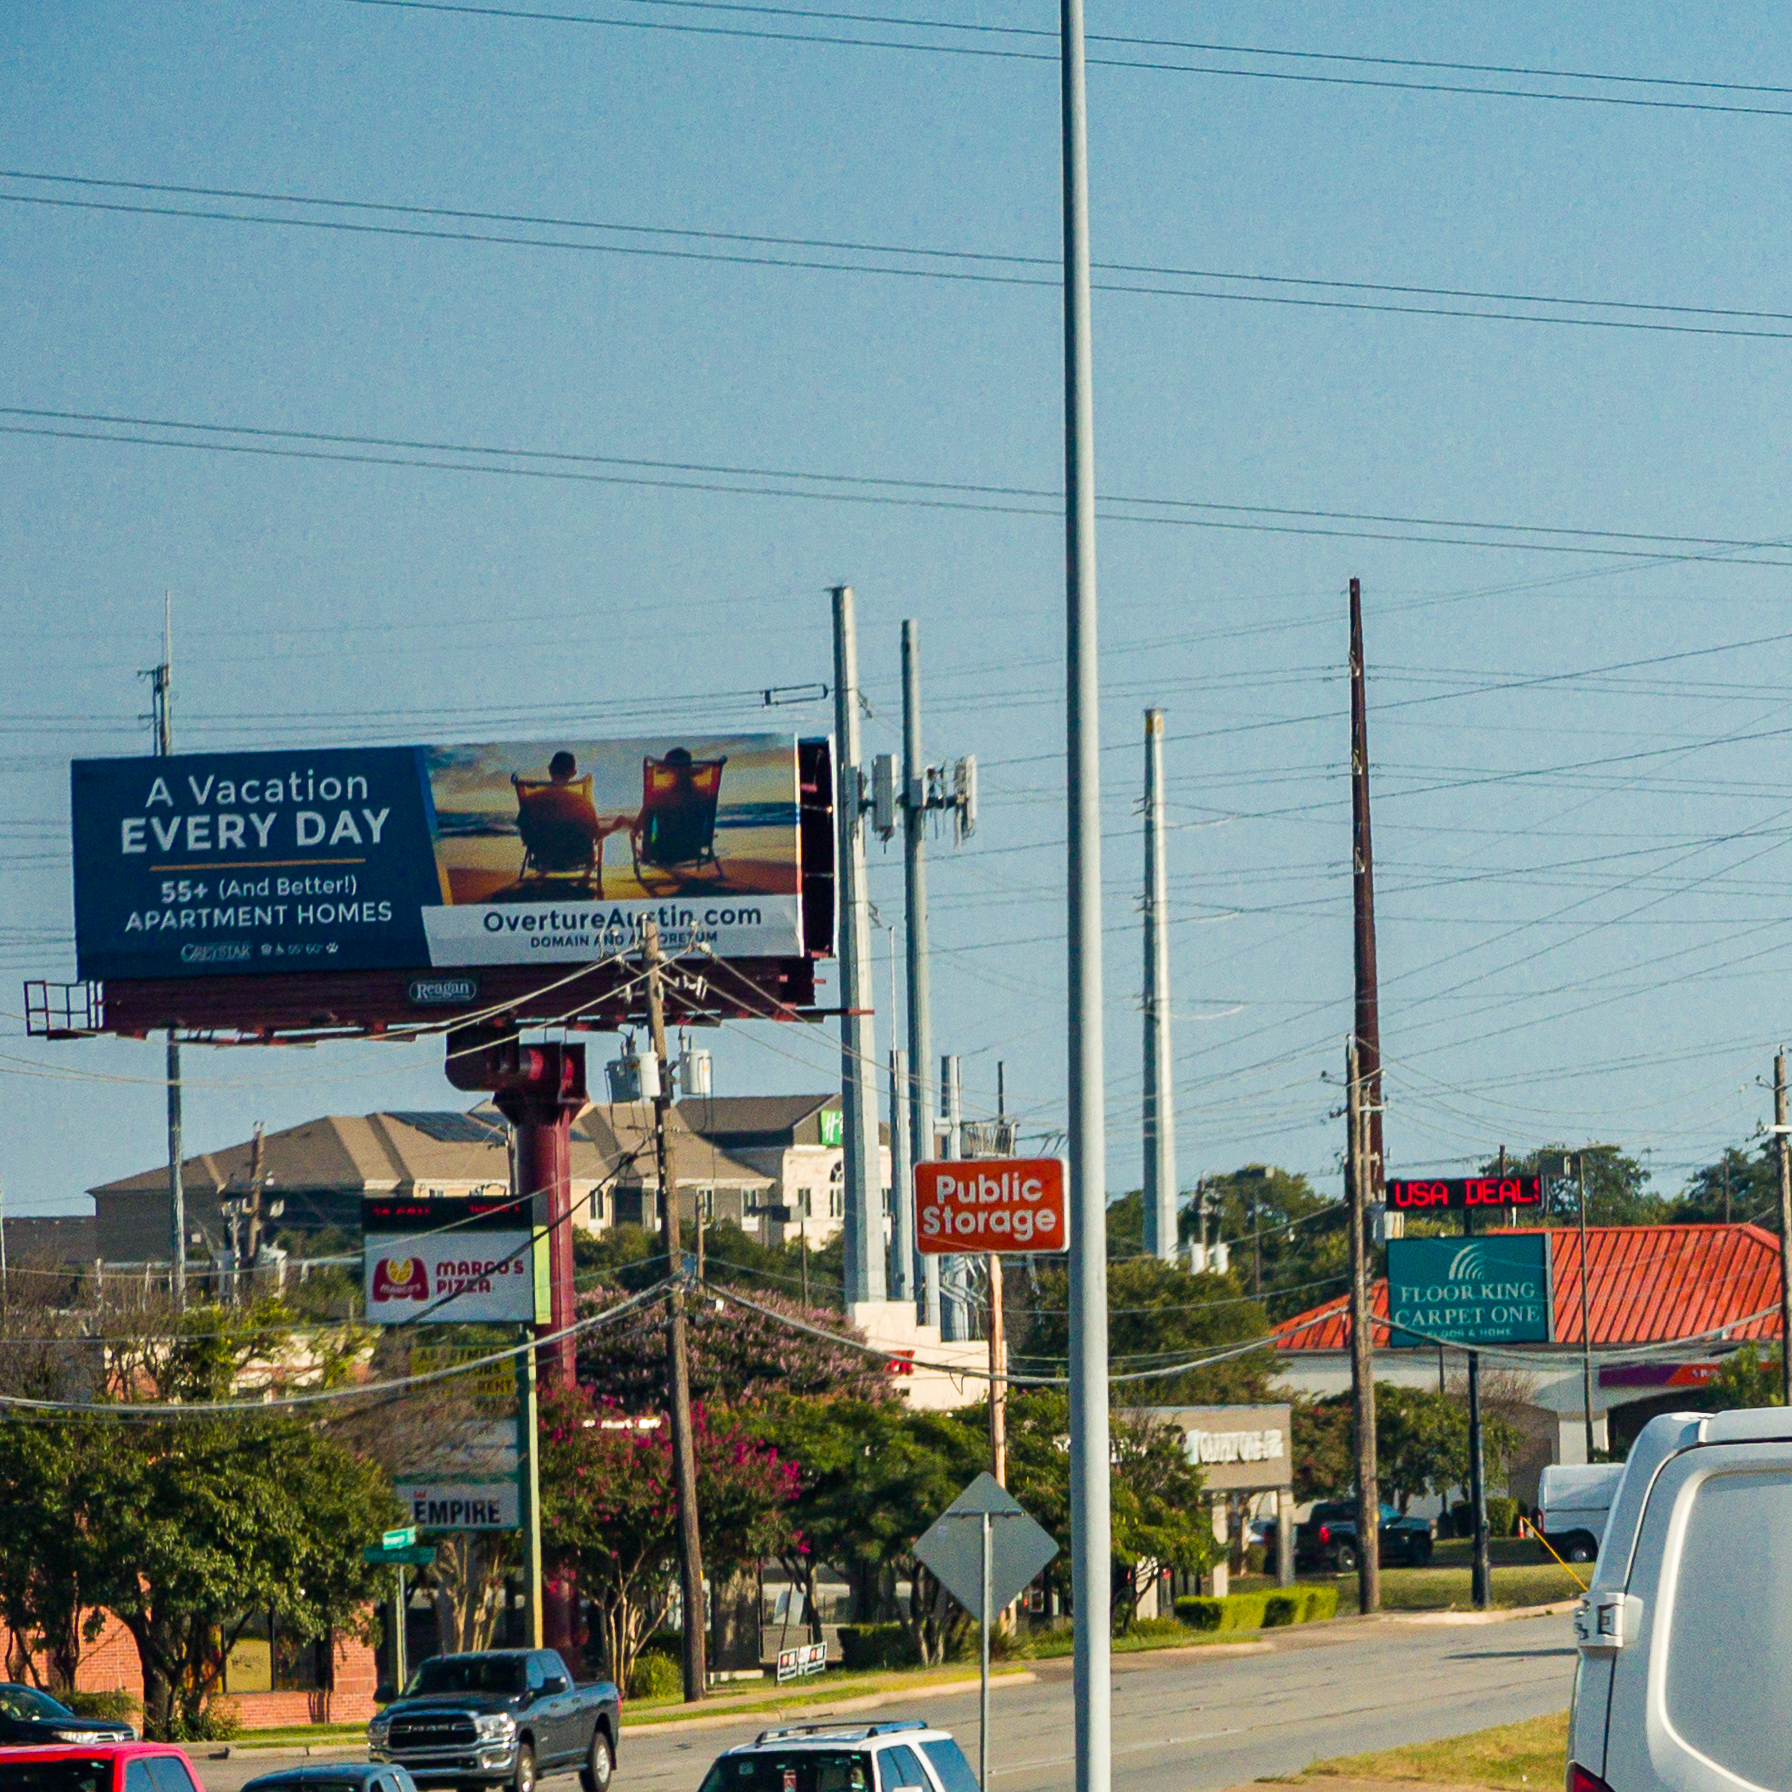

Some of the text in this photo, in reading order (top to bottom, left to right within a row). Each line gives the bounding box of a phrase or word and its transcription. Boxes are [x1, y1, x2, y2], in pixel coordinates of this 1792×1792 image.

[145, 769, 368, 808] A Vacation
[121, 807, 391, 854] EVERY DAY
[161, 874, 358, 903] 55+ (And Better!)
[124, 901, 392, 932] APARTMENT HOMES
[530, 935, 591, 948] DOMAIN
[416, 982, 470, 999] Reagan
[936, 1172, 1043, 1204] Public
[1395, 1182, 1448, 1207] USA
[923, 1205, 1056, 1241] Storage
[436, 1279, 491, 1294] PIZZA
[1401, 1281, 1535, 1303] FLOOR KING
[1395, 1305, 1540, 1326] CARPET ONE
[414, 1501, 501, 1524] EMPIRE
